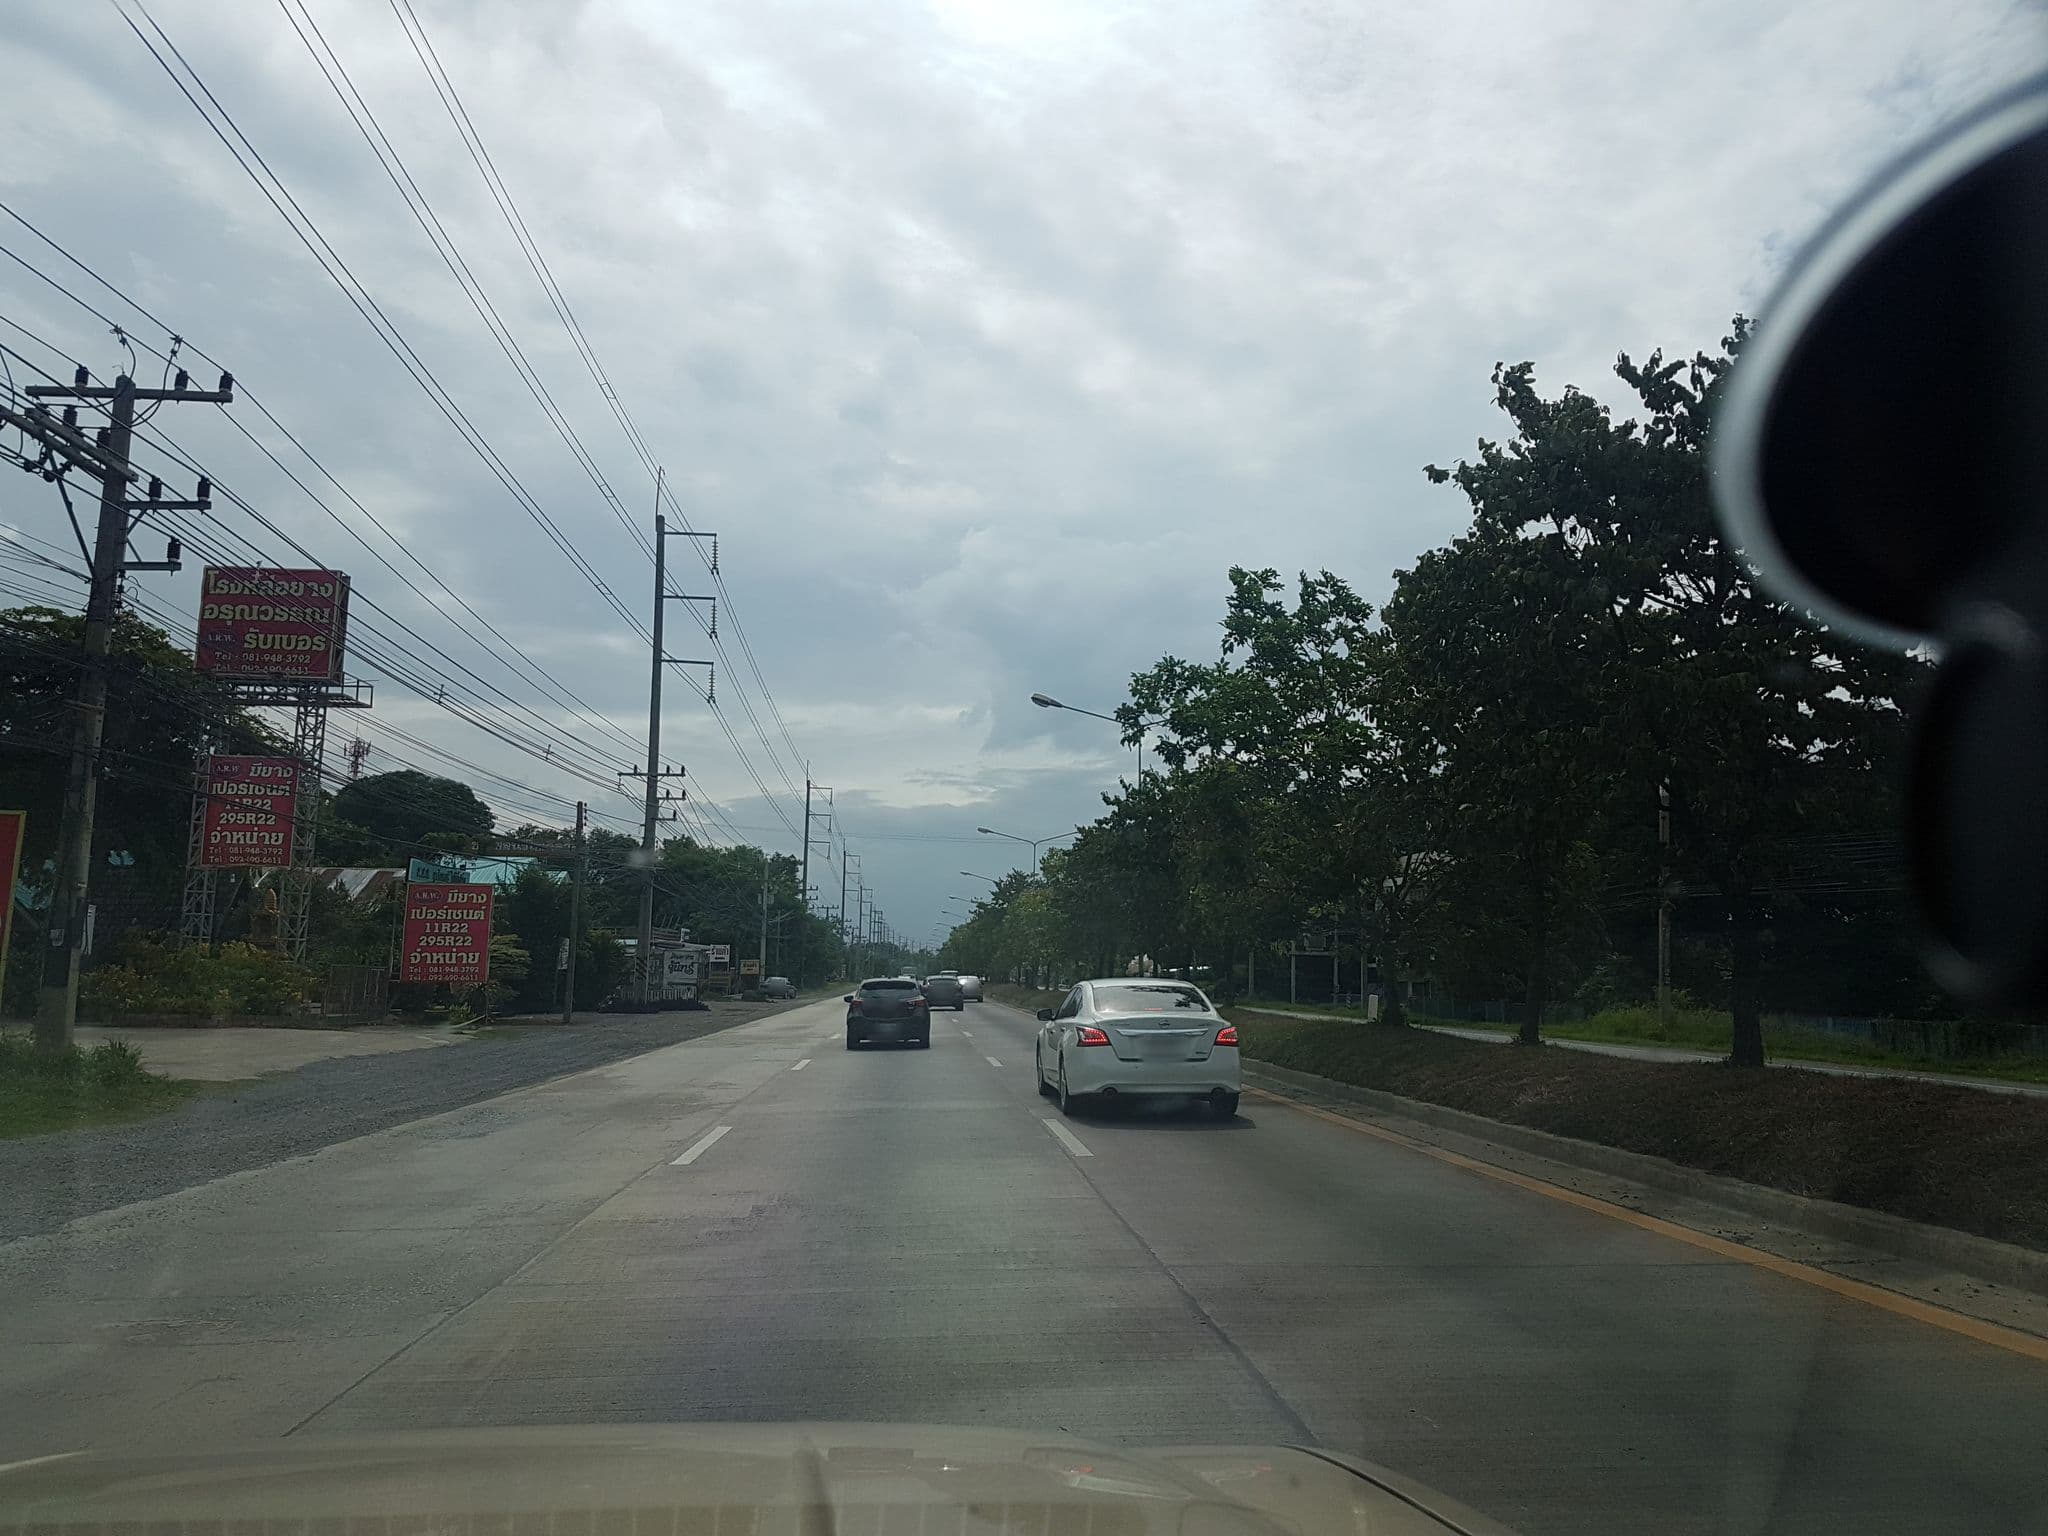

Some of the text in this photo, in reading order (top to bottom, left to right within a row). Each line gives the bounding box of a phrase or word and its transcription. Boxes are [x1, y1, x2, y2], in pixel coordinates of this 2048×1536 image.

[249, 762, 293, 777] มียาง
[219, 812, 276, 825] 295R22
[210, 826, 284, 845] จำหน่าย
[447, 890, 487, 904] มียาง
[424, 922, 469, 933] 11R22
[419, 936, 472, 946] 295R22
[410, 949, 480, 964] จำหน่าย
